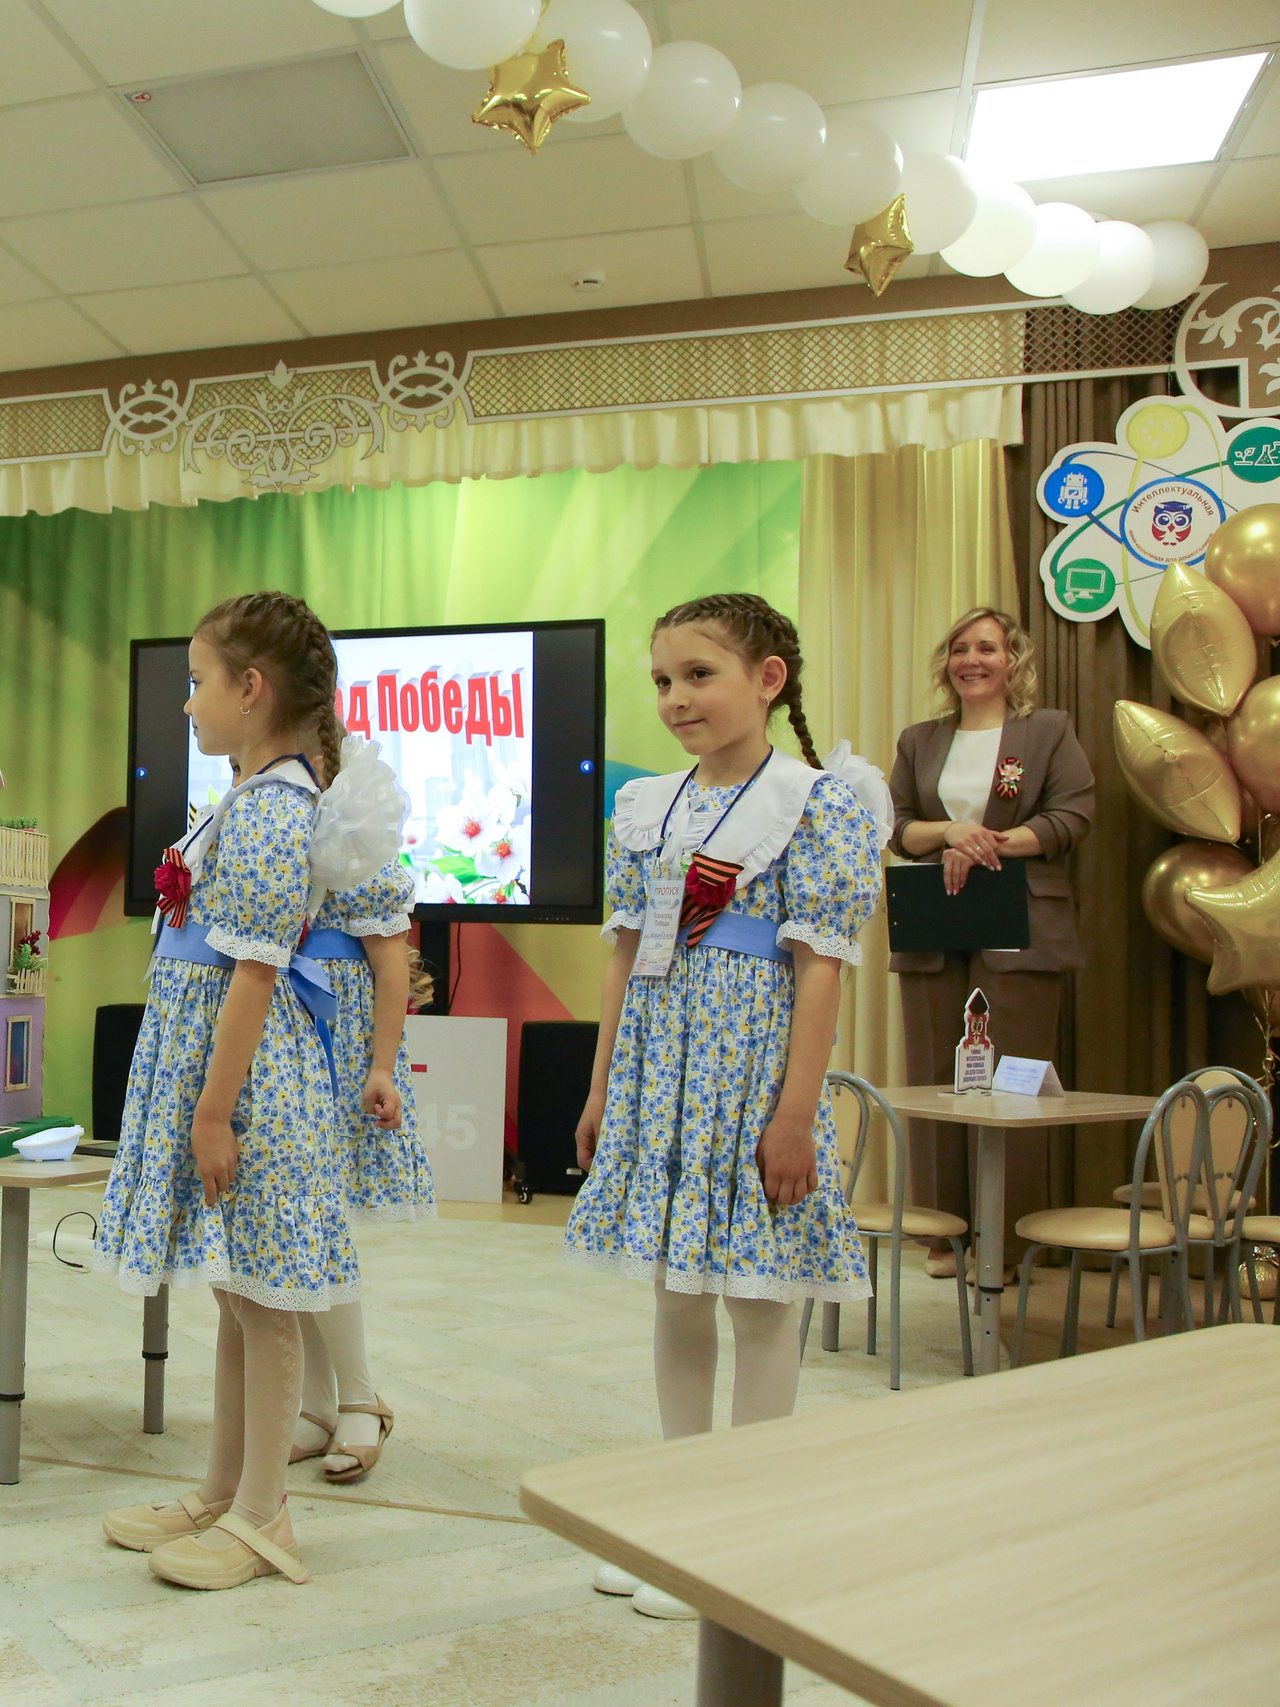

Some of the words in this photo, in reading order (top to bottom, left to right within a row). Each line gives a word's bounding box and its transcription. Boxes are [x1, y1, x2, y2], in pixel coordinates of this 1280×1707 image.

[1131, 486, 1214, 516] Интеллектуальная
[334, 684, 371, 740] д
[377, 667, 525, 746] Победы
[653, 886, 680, 896] ПРОПУСК
